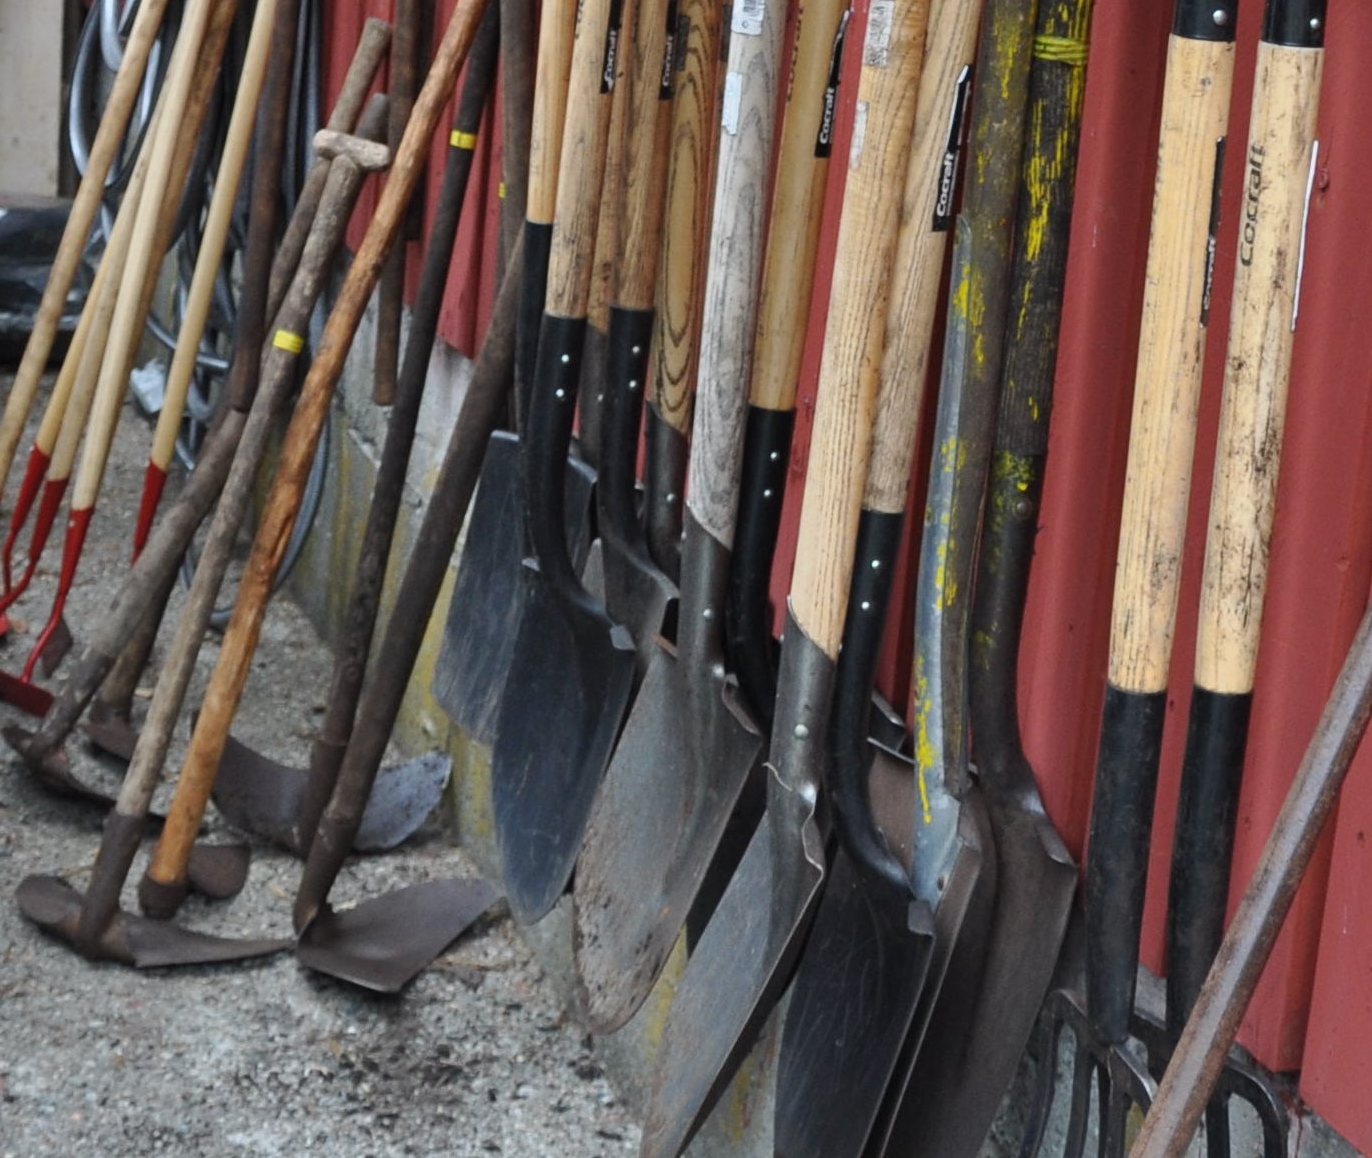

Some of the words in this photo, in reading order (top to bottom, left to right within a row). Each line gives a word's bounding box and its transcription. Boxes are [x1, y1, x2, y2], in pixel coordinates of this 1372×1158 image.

[820, 86, 836, 145] Cocraft
[935, 151, 955, 218] Cocraft
[1240, 143, 1266, 267] Cocraft
